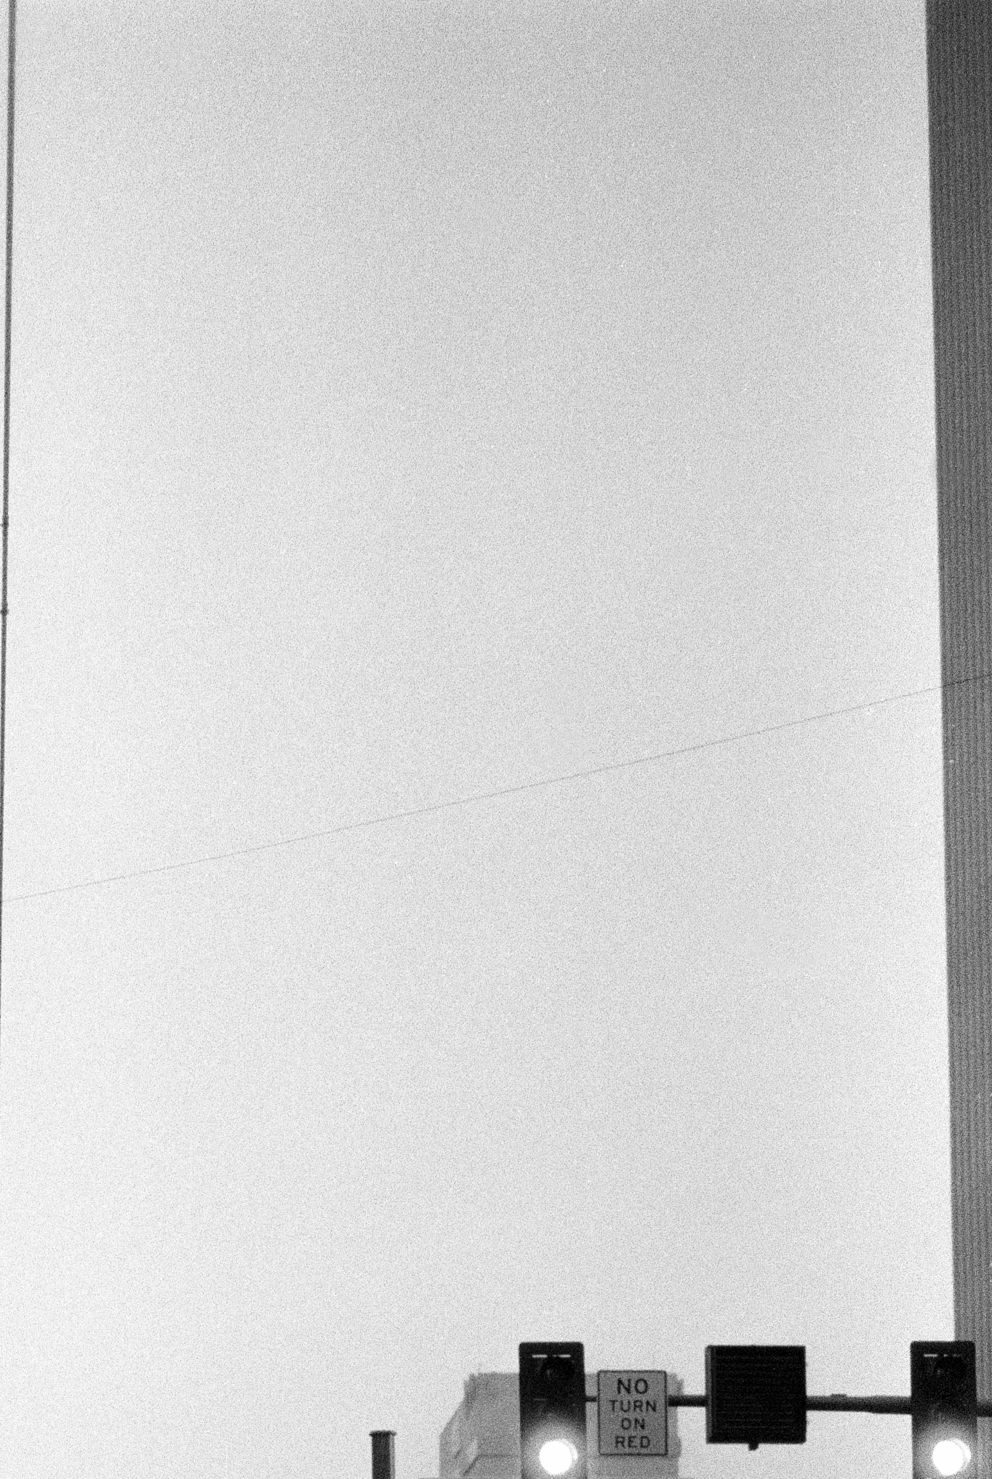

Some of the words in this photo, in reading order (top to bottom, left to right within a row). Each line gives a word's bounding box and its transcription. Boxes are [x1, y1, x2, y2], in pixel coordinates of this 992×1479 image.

[617, 1378, 648, 1394] NO
[609, 1399, 657, 1412] TURN
[621, 1418, 645, 1430] ON
[615, 1436, 650, 1448] RED
